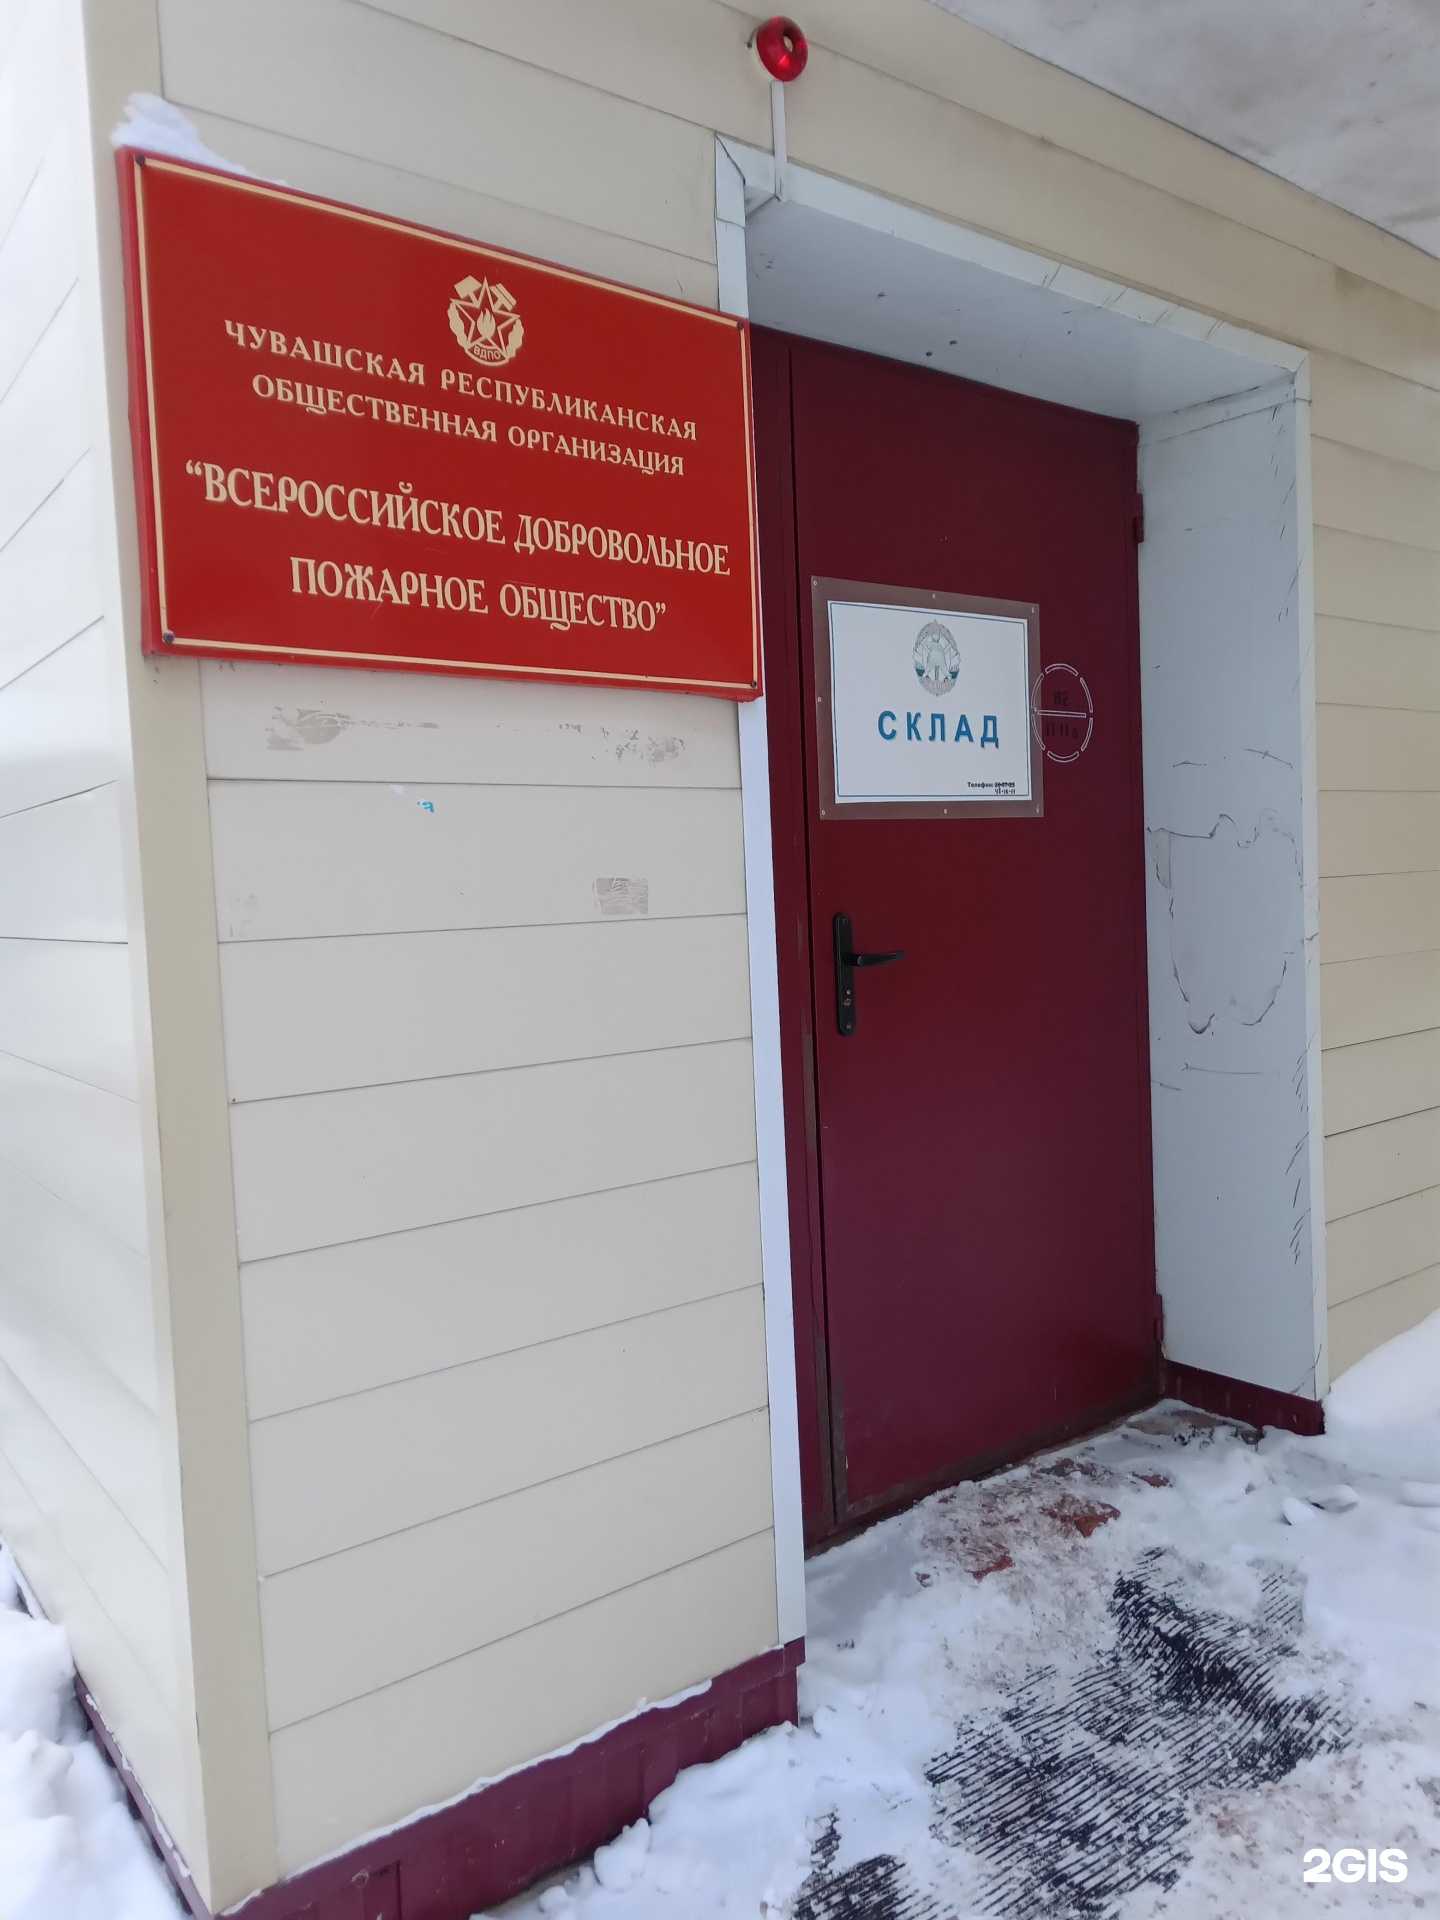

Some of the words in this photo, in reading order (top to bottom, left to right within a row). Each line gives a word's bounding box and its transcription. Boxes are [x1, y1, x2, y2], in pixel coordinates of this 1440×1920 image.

[225, 320, 424, 385] ЧУВАШСКАЯ
[441, 369, 696, 440] РЕСПУБЛИКАНСКАЯ
[473, 344, 501, 361] ВДПО
[253, 375, 496, 442] ОБЩЕСТВЕННАЯ
[508, 426, 683, 475] ОРГАНИЗАЦИЯ
[186, 460, 505, 544] “ВСЕРОССИЙСКОЕ
[514, 514, 730, 575] ДОБРОВОЛЬНОЕ
[290, 557, 488, 613] ПОЖАРНОЕ
[500, 584, 665, 631] ОБЩЕСТВО”
[878, 710, 999, 749] СКЛАД
